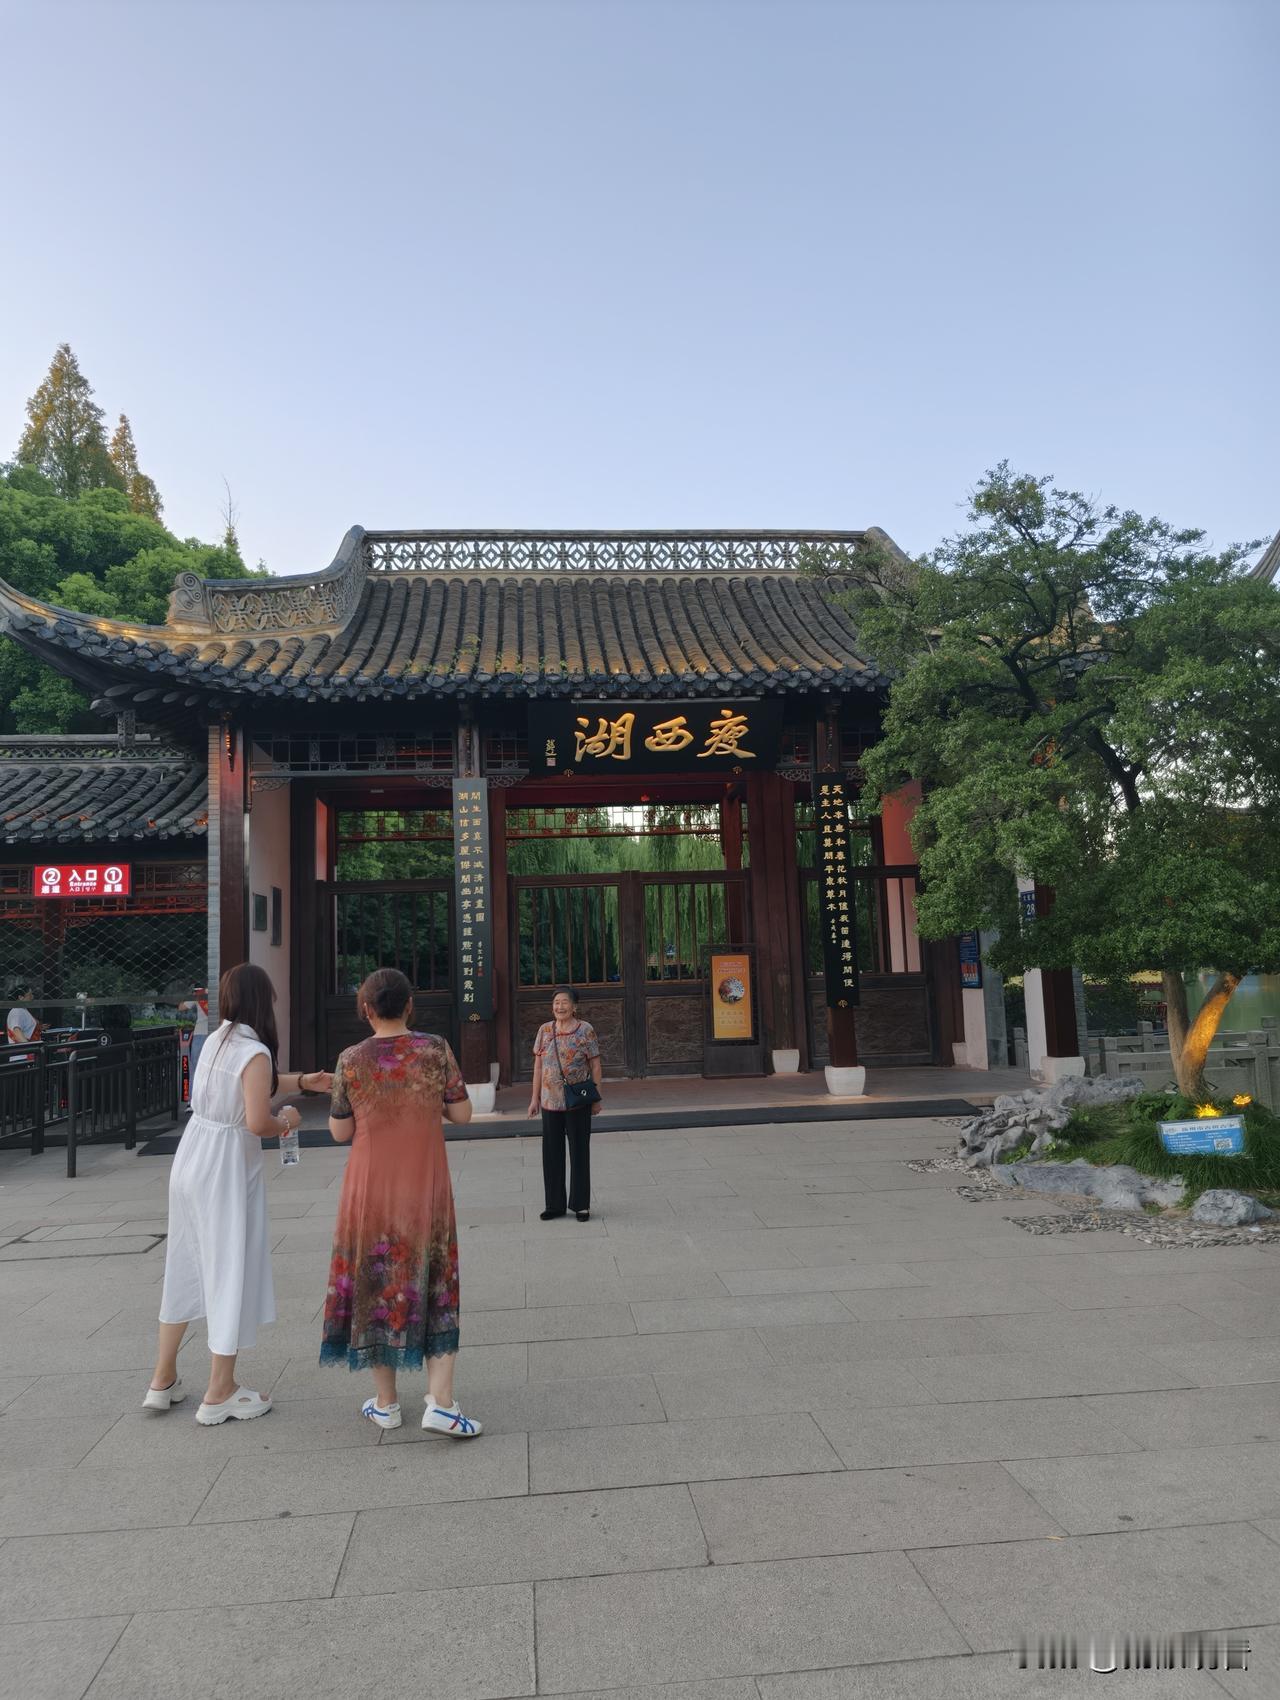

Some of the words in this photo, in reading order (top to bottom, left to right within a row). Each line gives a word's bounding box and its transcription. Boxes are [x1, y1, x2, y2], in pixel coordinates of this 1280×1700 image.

[574, 709, 757, 762] 瘦西湖
[68, 869, 97, 881] 入口
[101, 1035, 108, 1046] 9
